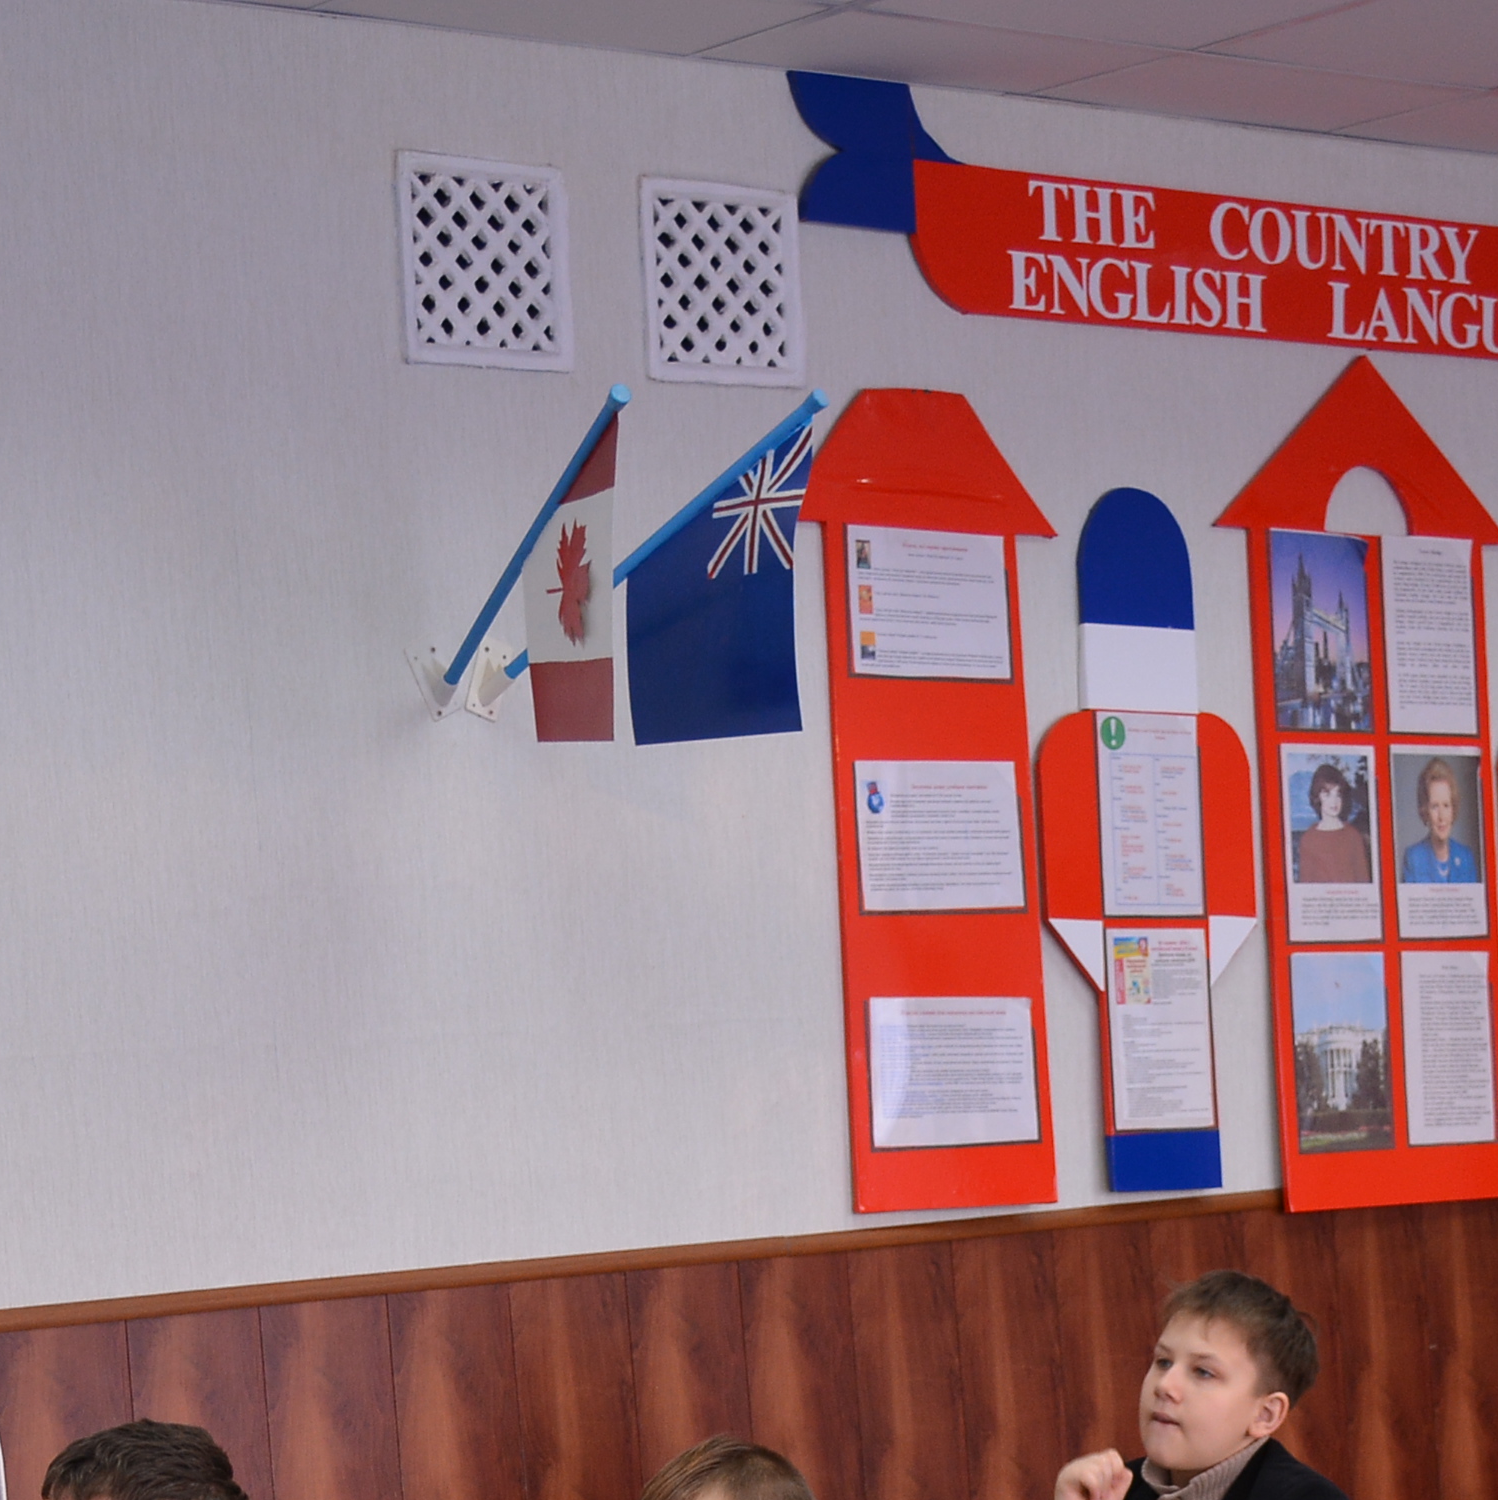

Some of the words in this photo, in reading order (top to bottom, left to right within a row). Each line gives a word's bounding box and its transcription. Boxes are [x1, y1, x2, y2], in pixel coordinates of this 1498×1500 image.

[1028, 179, 1156, 249] THE
[1209, 201, 1478, 285] COUNTRY
[1007, 249, 1267, 332] ENGLISH
